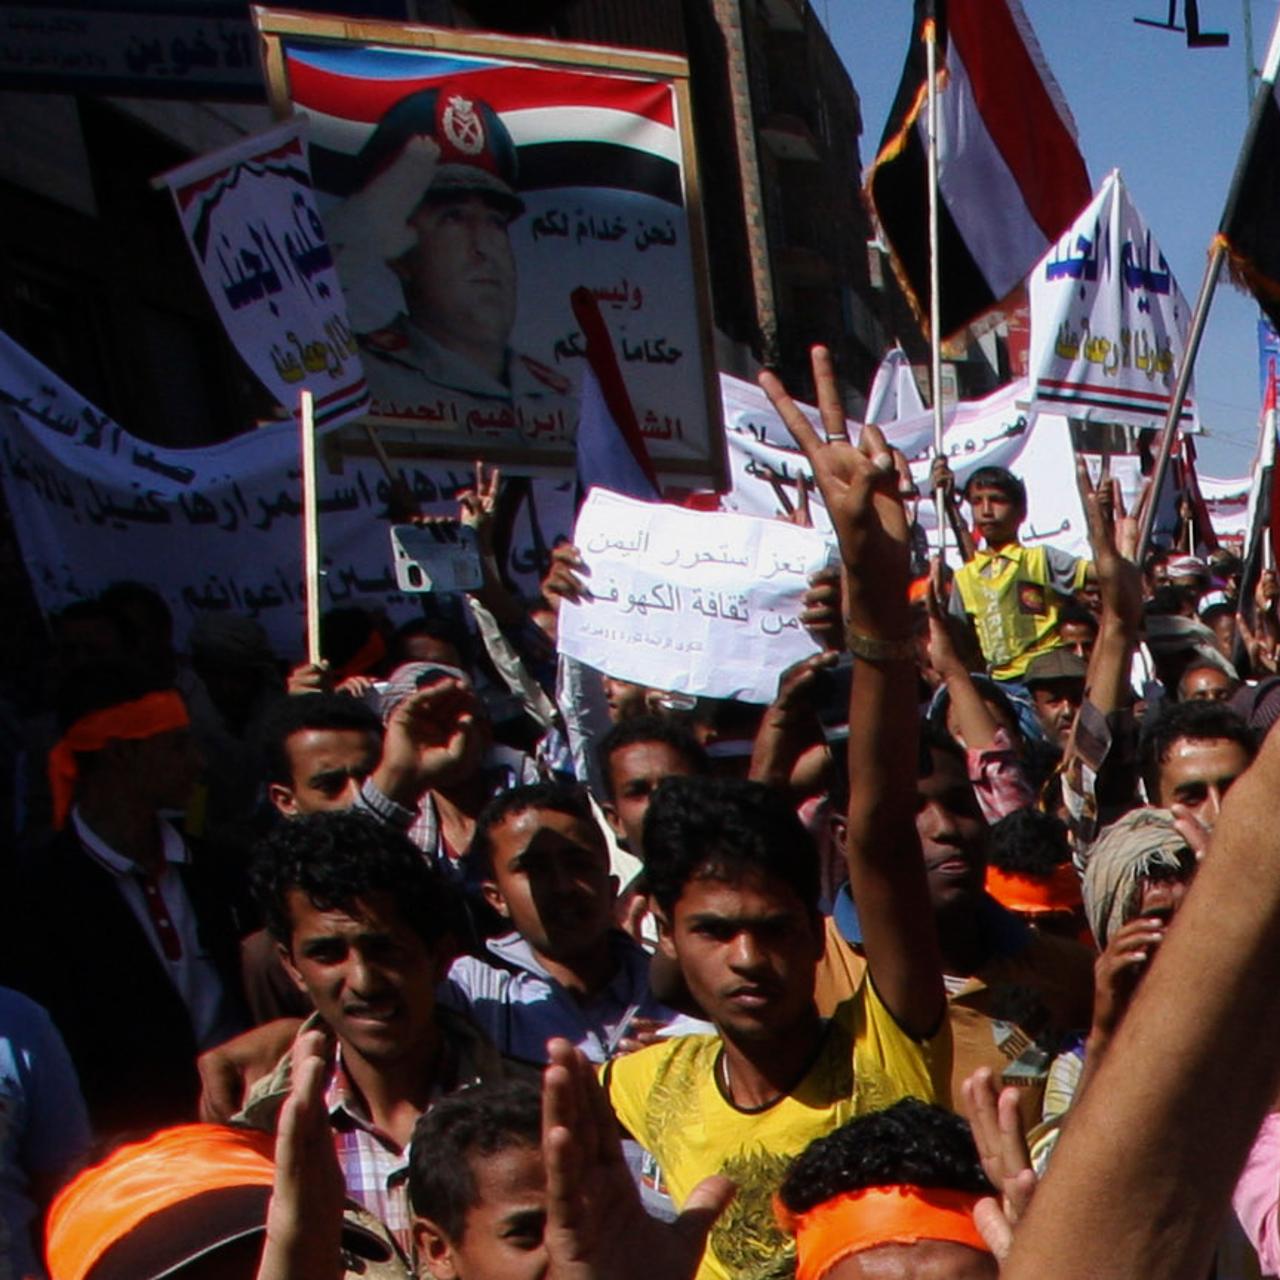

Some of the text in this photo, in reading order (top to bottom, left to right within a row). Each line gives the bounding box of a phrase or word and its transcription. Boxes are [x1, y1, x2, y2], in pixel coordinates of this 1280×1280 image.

[531, 209, 569, 243] لكم
[634, 218, 677, 252] نحن
[586, 528, 807, 580] تعز ستحرر اليمن
[590, 576, 803, 635] من ثقافة الكهوف
